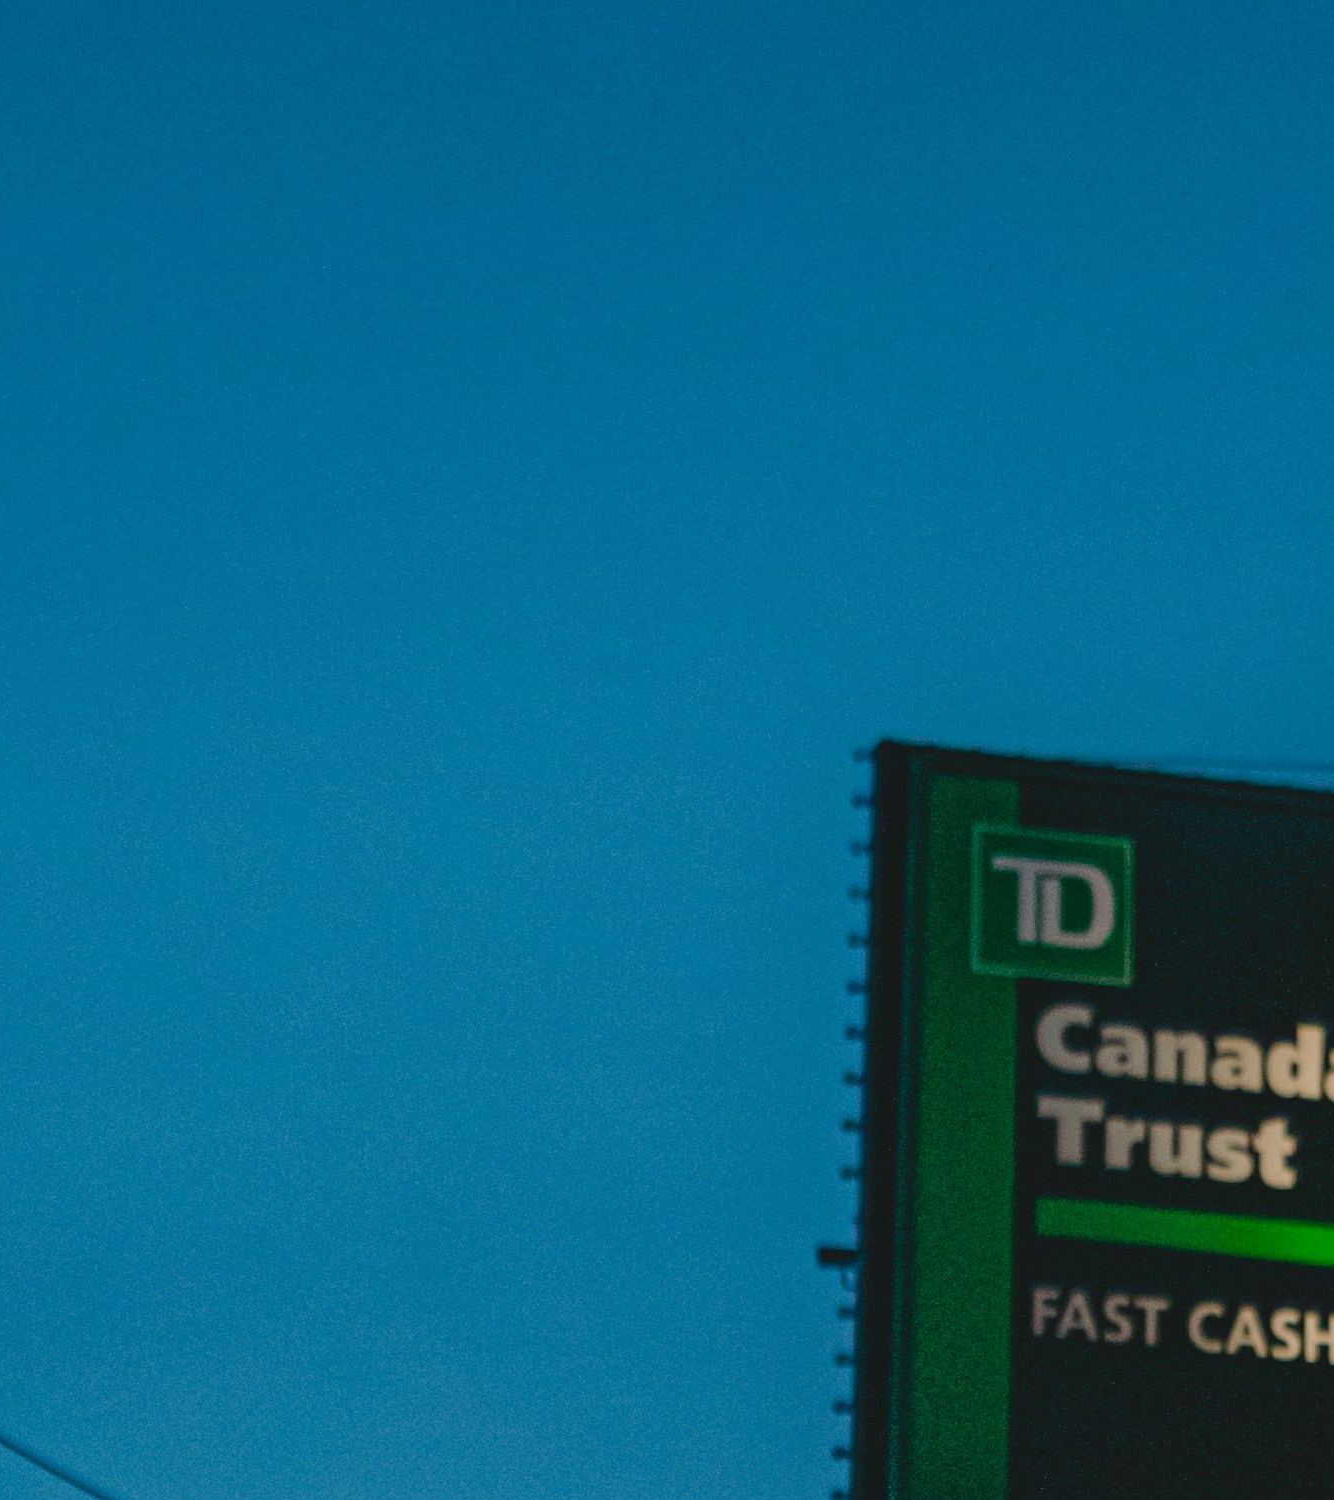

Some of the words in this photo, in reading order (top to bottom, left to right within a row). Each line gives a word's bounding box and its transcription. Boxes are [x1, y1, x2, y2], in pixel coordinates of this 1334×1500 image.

[990, 854, 1117, 951] TD
[1035, 1094, 1300, 1191] Trust
[1029, 1285, 1171, 1347] FAST
